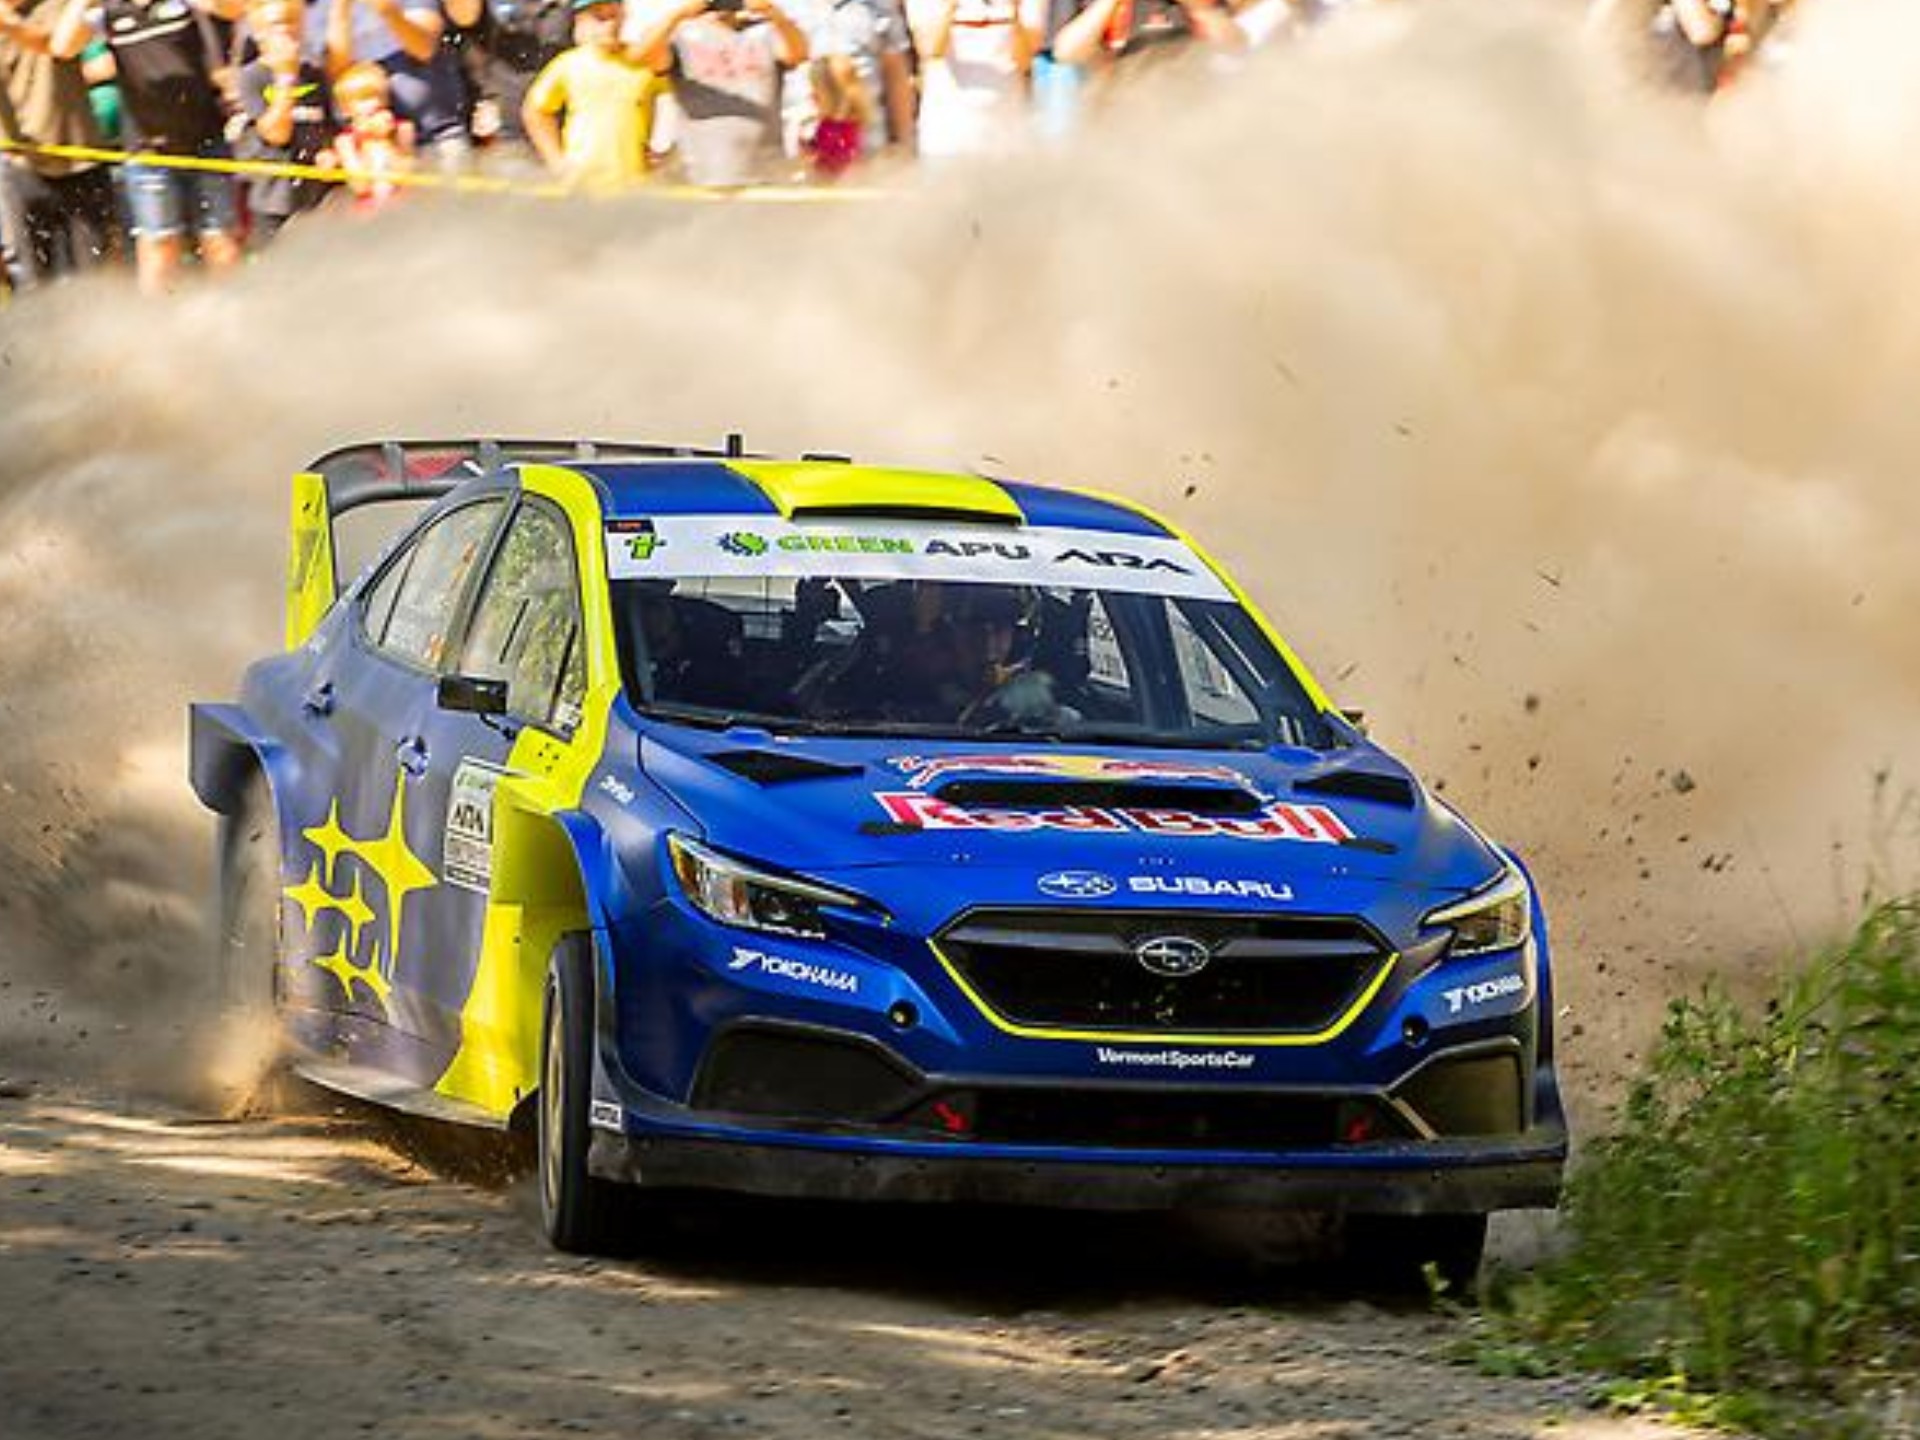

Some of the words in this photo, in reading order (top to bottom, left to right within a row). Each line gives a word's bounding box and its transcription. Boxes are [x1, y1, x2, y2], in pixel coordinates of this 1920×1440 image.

[777, 535, 914, 554] GREEN
[926, 539, 1031, 560] APU
[1054, 549, 1195, 576] ARA
[872, 791, 1128, 832] Red
[1113, 802, 1357, 845] Bull
[1128, 876, 1294, 900] SUBARU
[758, 952, 859, 992] YOKOHAMA
